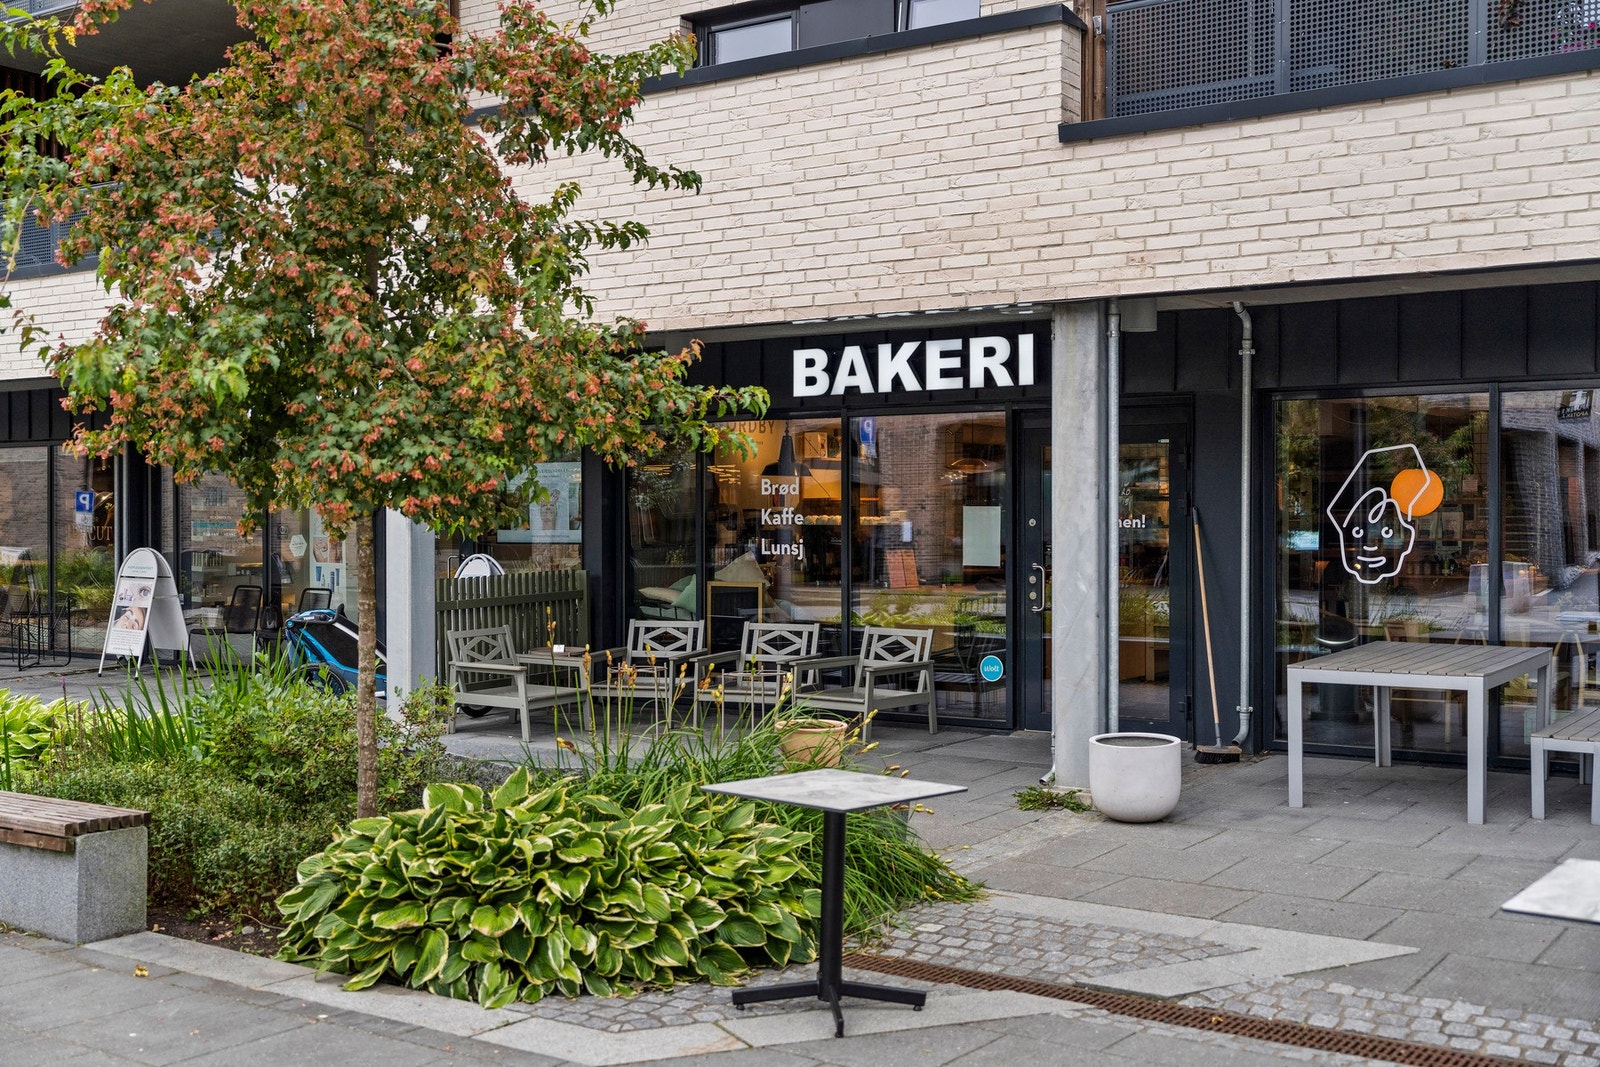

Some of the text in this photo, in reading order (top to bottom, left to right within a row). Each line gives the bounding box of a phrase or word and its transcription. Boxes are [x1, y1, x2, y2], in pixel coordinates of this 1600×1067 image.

[793, 333, 1034, 397] BAKERI
[761, 477, 800, 496] Brød
[761, 507, 804, 526] Kaffe
[761, 538, 804, 561] Lunsj
[983, 664, 1000, 672] Wolt
